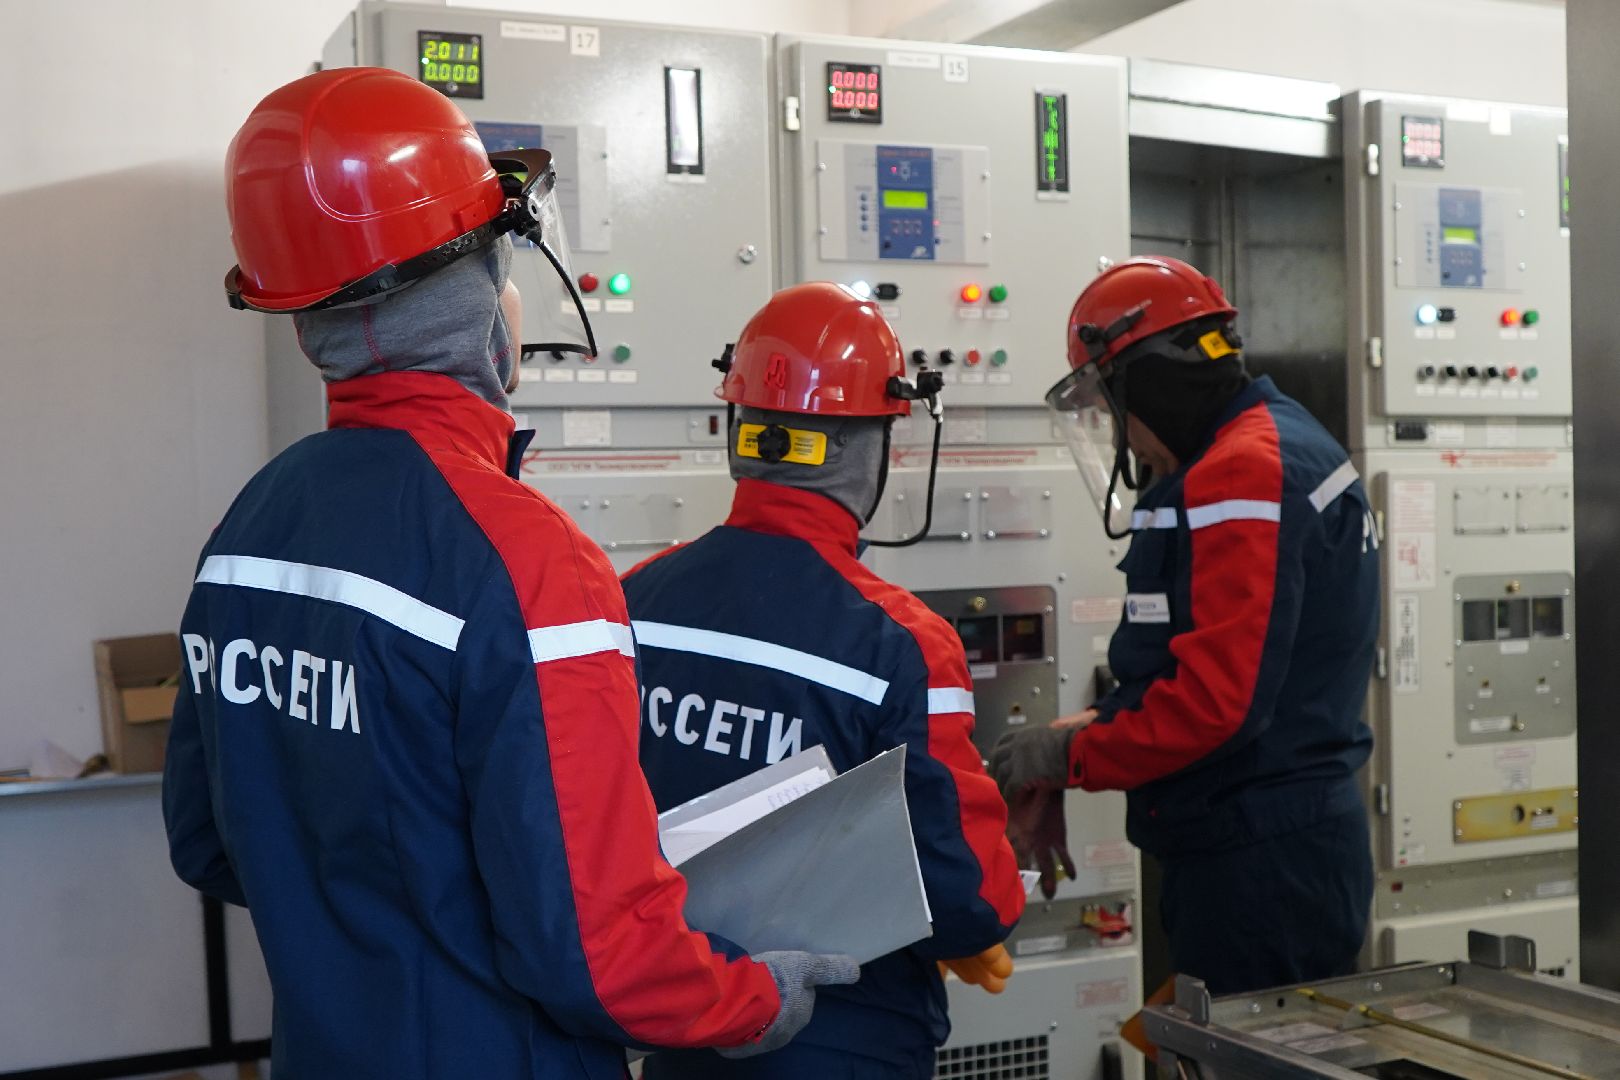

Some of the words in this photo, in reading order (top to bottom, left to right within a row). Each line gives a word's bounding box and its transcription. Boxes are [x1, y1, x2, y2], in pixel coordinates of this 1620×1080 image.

[424, 40, 479, 61] 2.011
[577, 33, 595, 48] 17
[424, 62, 479, 83] 0.000
[641, 685, 803, 764] ССЕТИ
